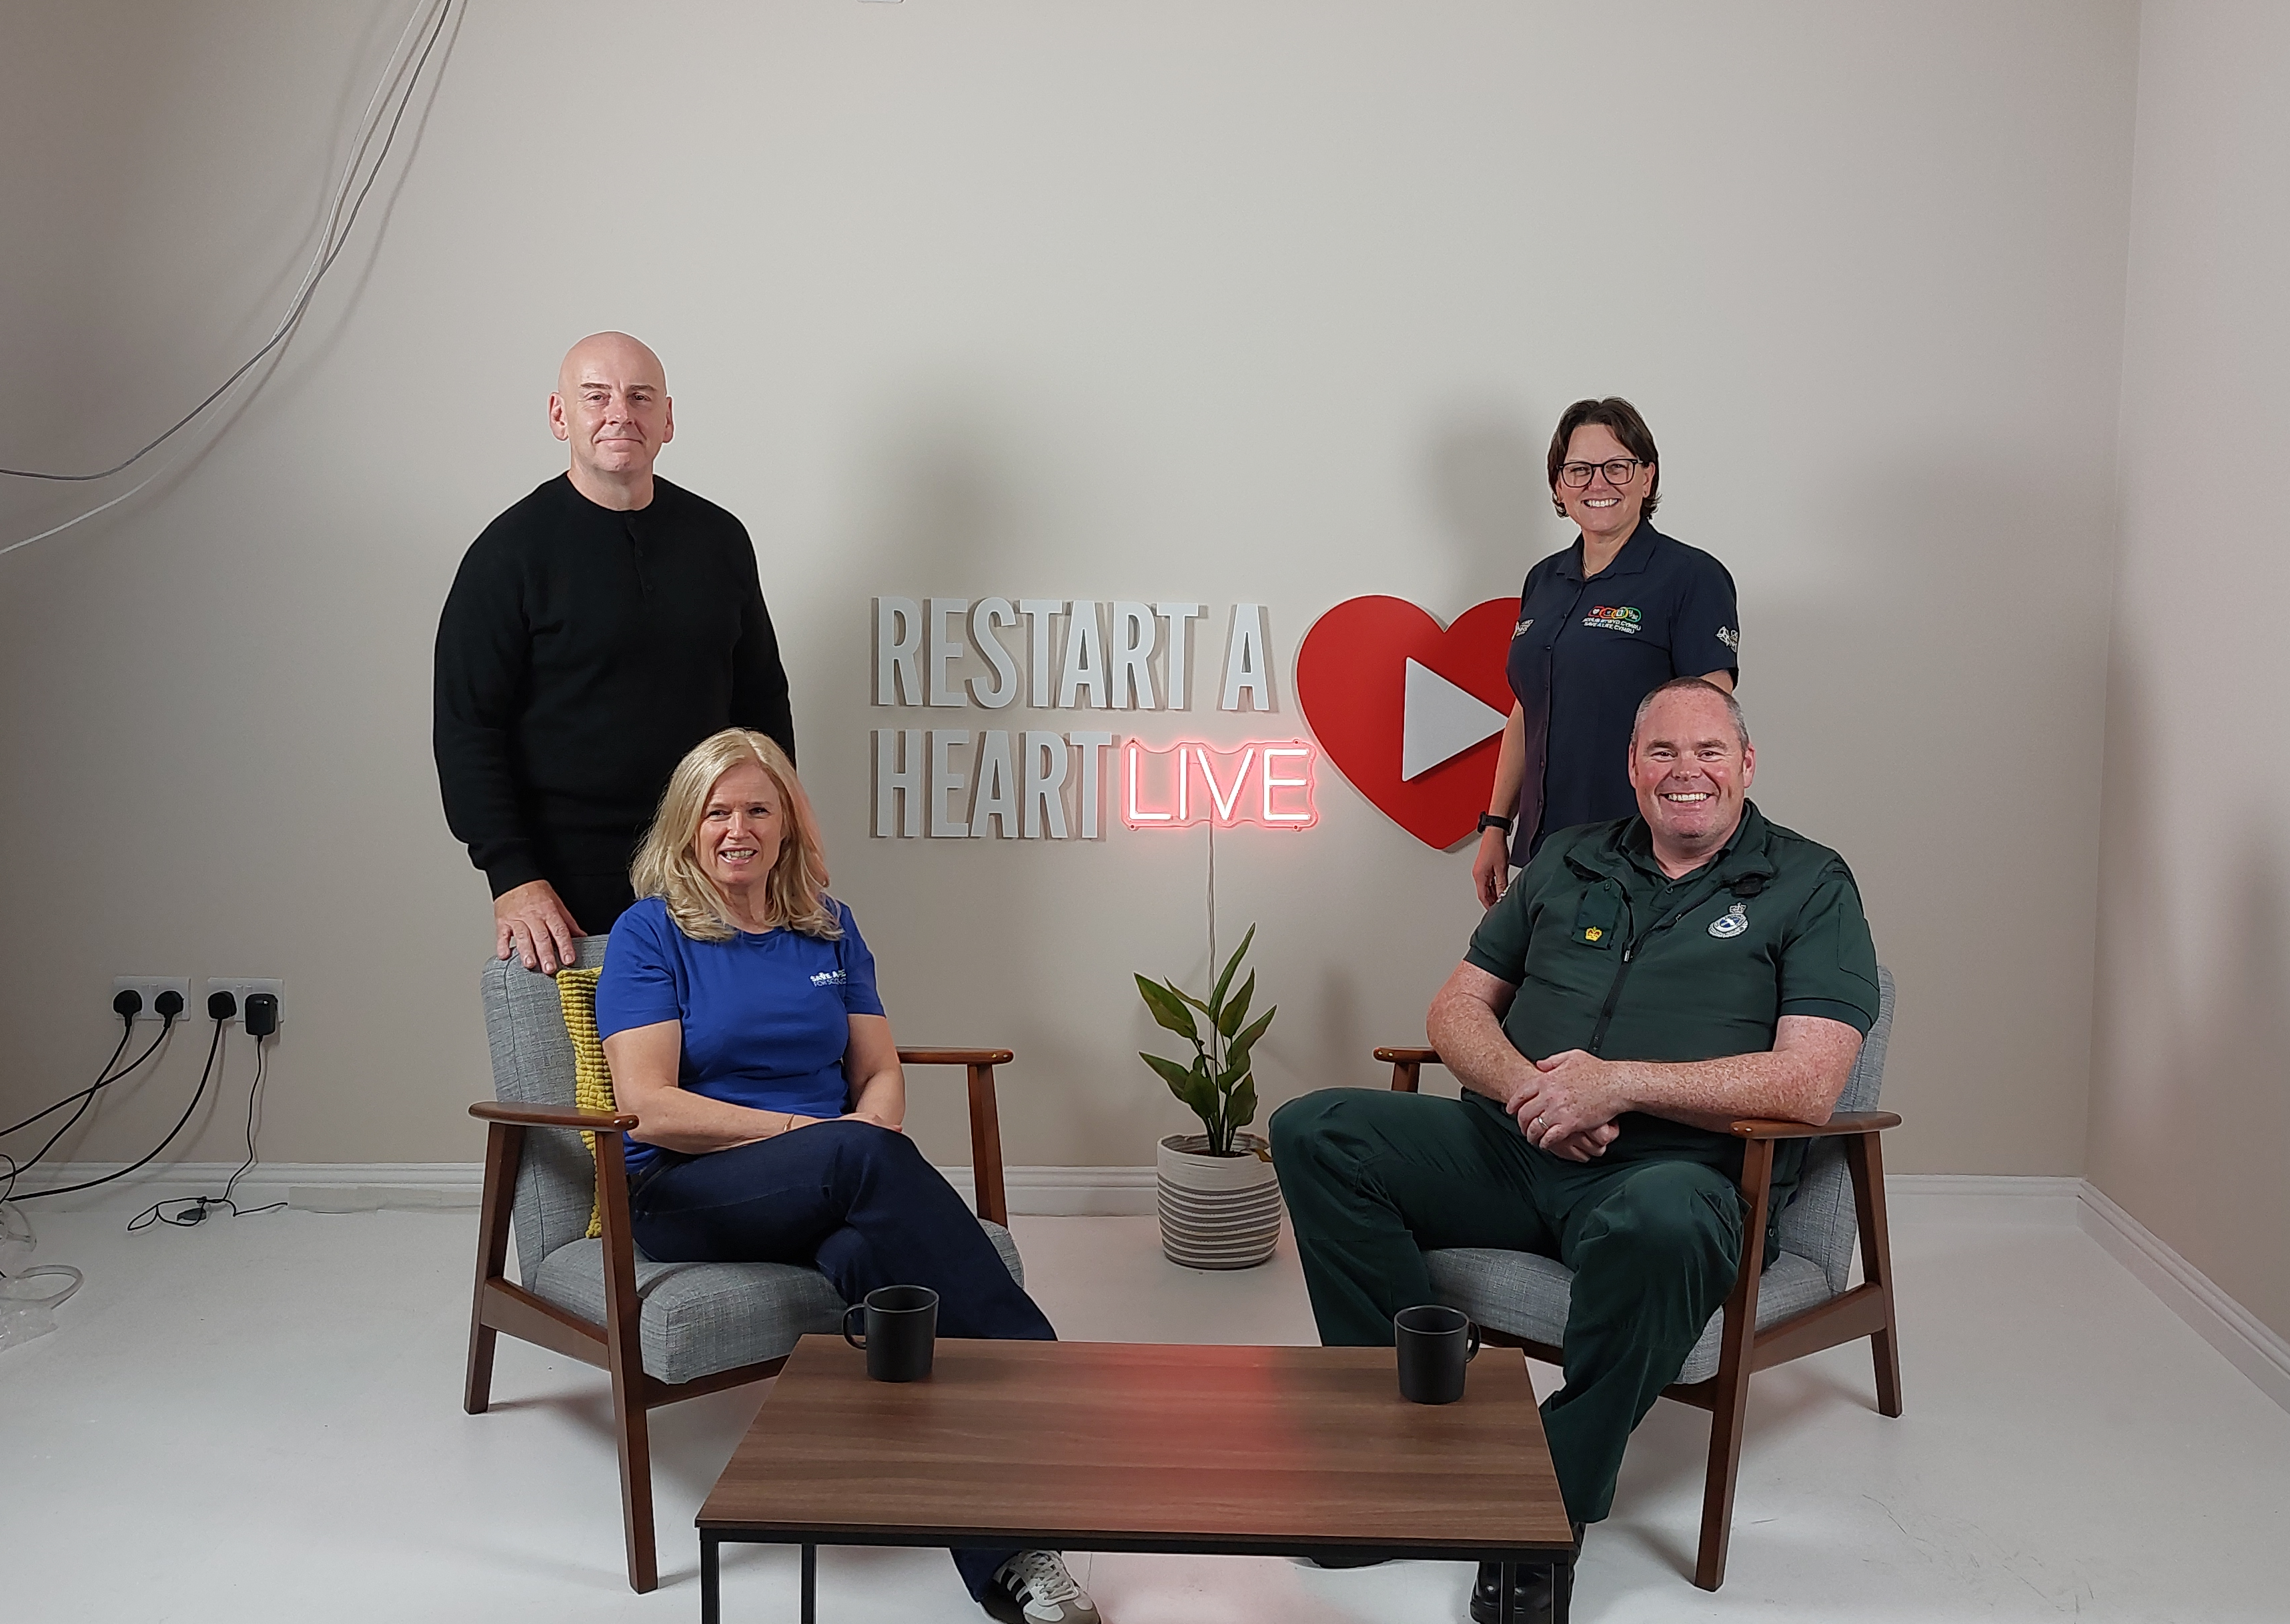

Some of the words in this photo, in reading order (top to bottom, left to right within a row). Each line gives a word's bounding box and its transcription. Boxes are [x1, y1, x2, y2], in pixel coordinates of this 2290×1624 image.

[877, 596, 1200, 709] RESTART
[1221, 603, 1269, 712] A
[876, 728, 1113, 839] HEART
[1127, 746, 1312, 822] LIVE
